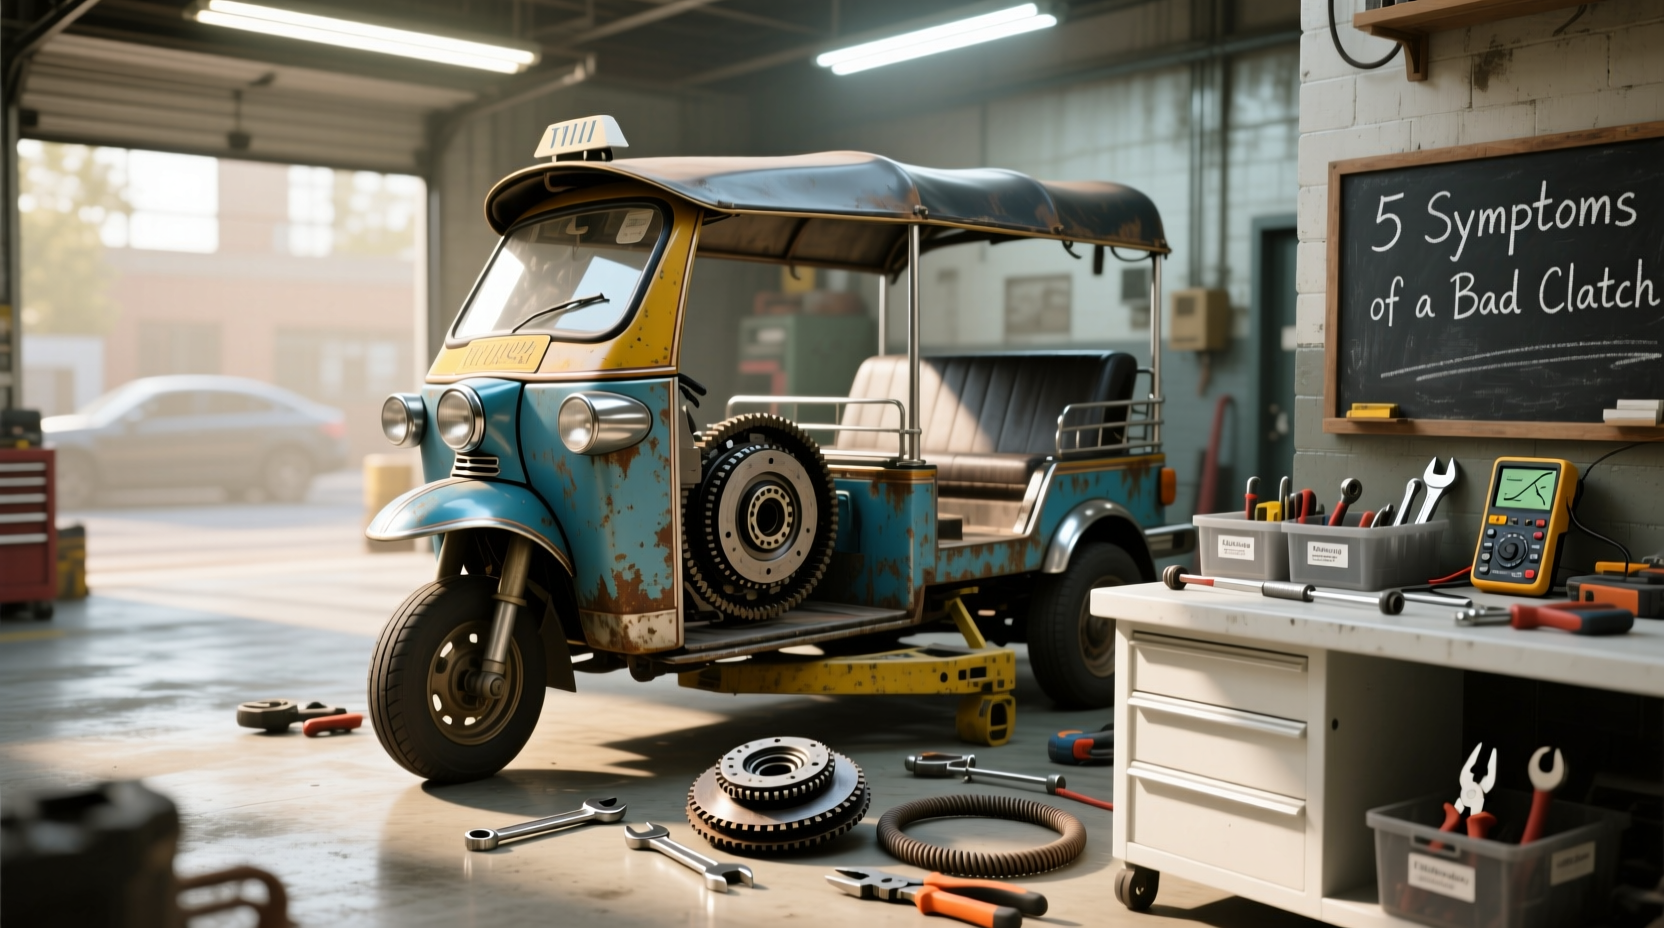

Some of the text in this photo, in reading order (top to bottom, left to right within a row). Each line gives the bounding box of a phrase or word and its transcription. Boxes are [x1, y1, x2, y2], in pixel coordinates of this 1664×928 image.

[1371, 180, 1638, 262] 5 Symptoms
[1369, 258, 1661, 327] of a Bad Clatch
